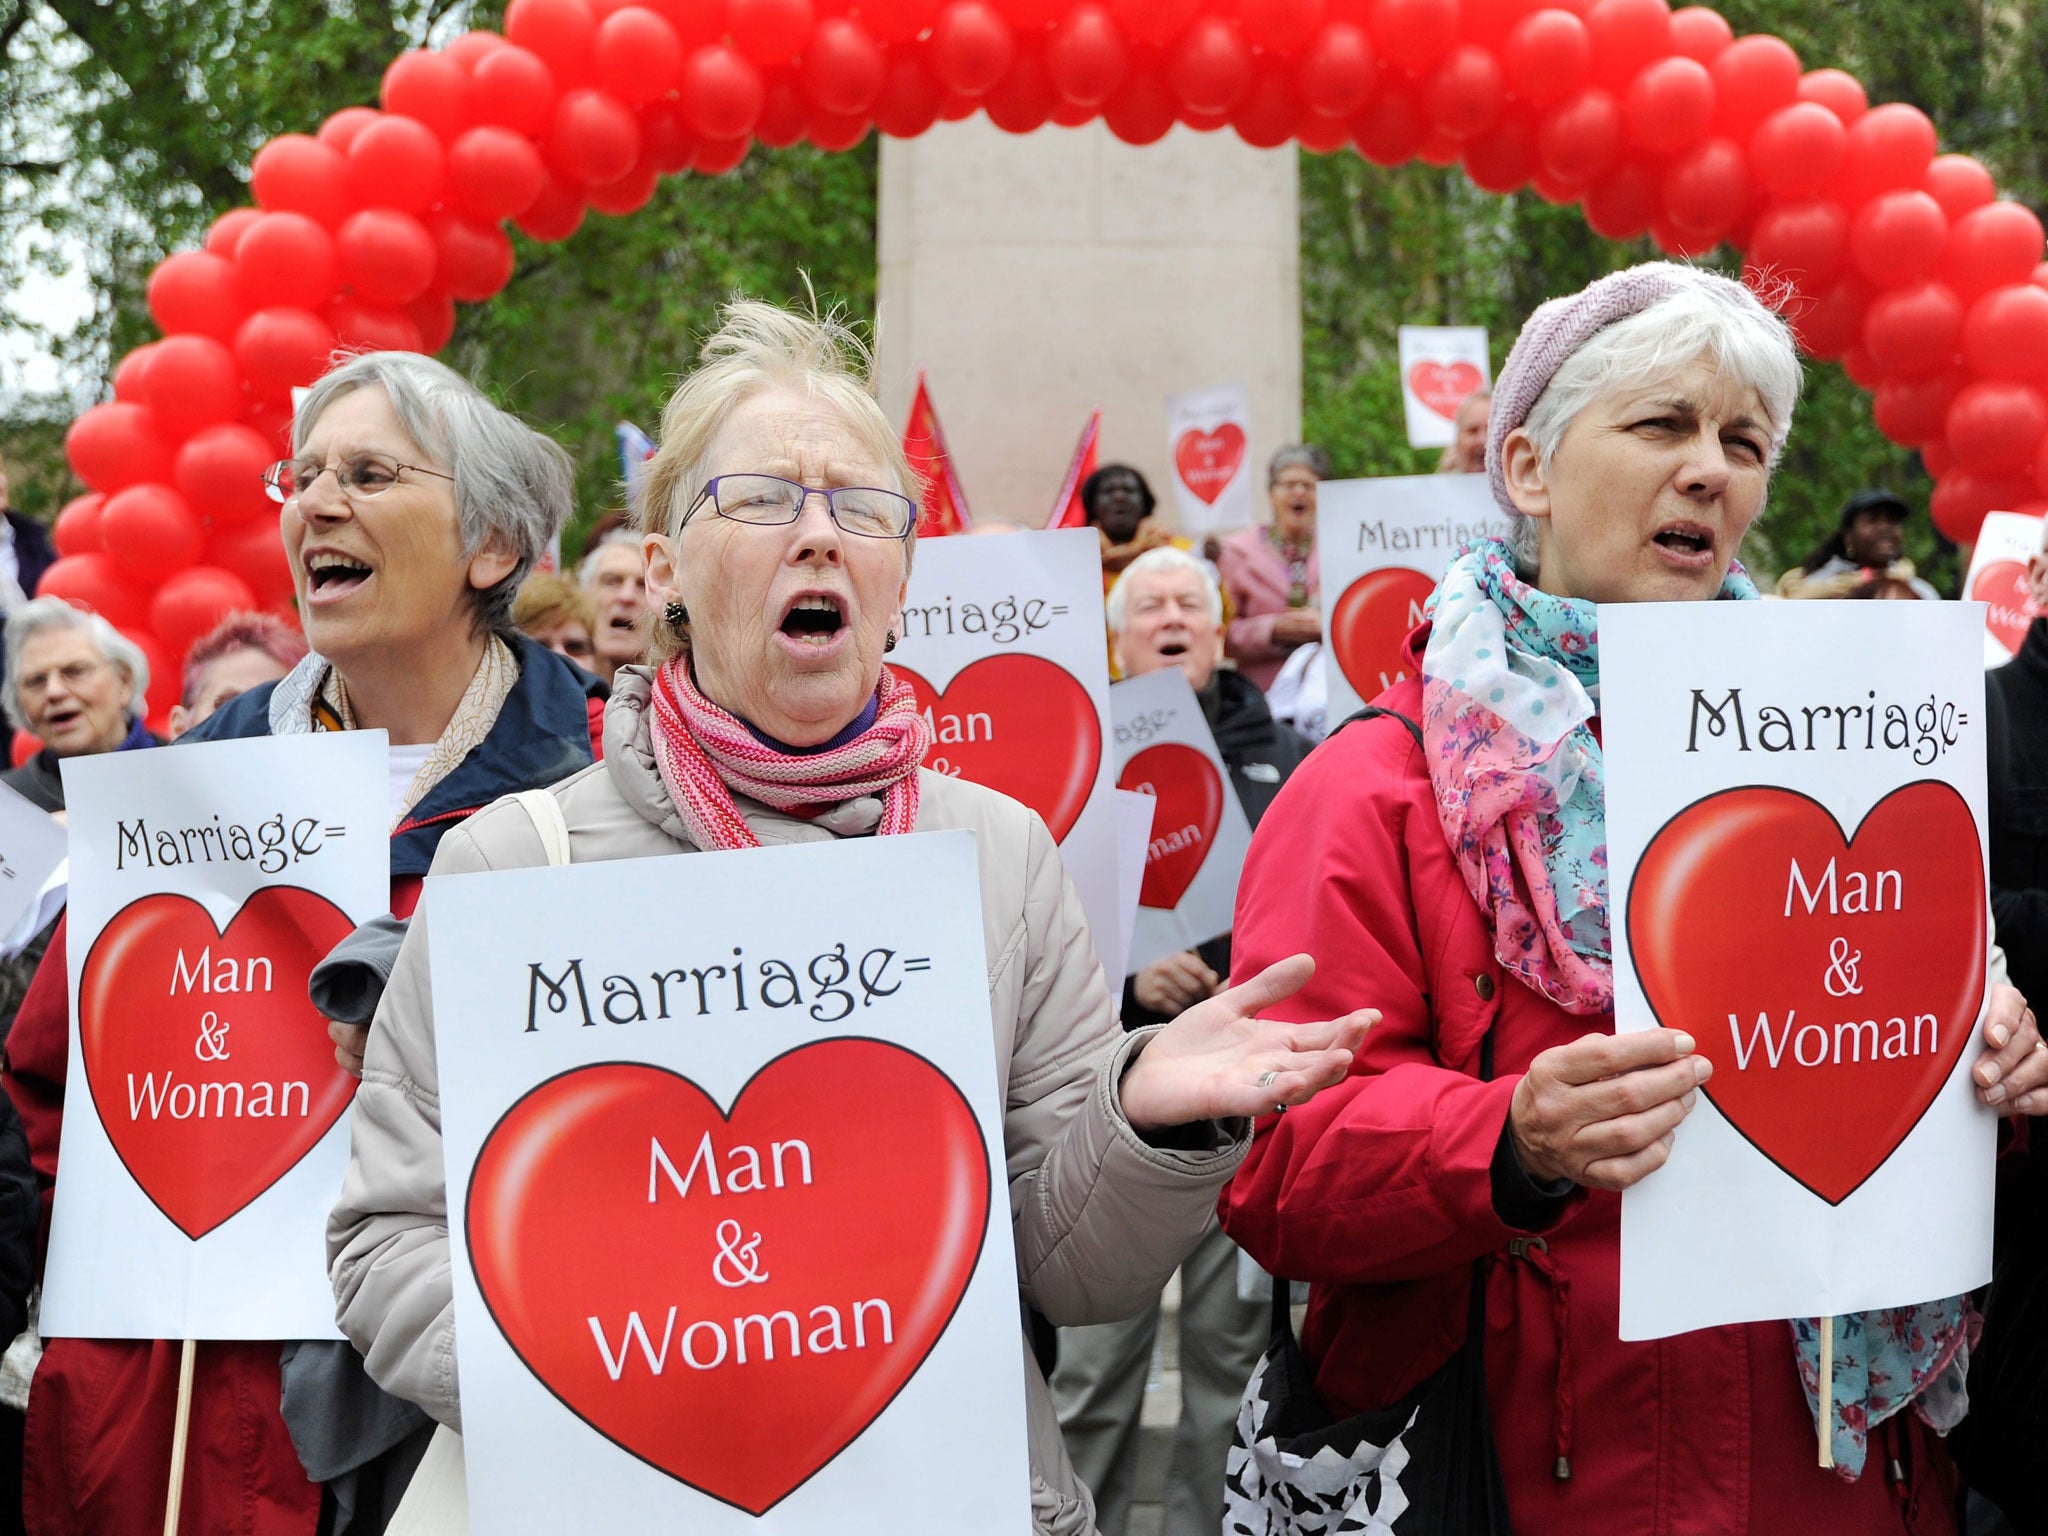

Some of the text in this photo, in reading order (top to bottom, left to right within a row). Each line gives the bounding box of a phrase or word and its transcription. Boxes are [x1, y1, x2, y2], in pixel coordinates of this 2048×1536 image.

[901, 595, 1069, 644] rriage=
[1685, 688, 1968, 766] Marriage=
[115, 812, 347, 874] Marriage=
[1147, 824, 1202, 865] man
[1783, 855, 1903, 918] Man
[169, 946, 273, 997] Man
[523, 942, 932, 1034] Marriage=
[1823, 936, 1864, 997] &
[194, 1011, 230, 1062] &
[1727, 1009, 1938, 1071] Woman
[126, 1071, 311, 1121] Woman
[647, 1130, 815, 1203] Man
[711, 1218, 769, 1289] &
[586, 1296, 895, 1382] Woman
